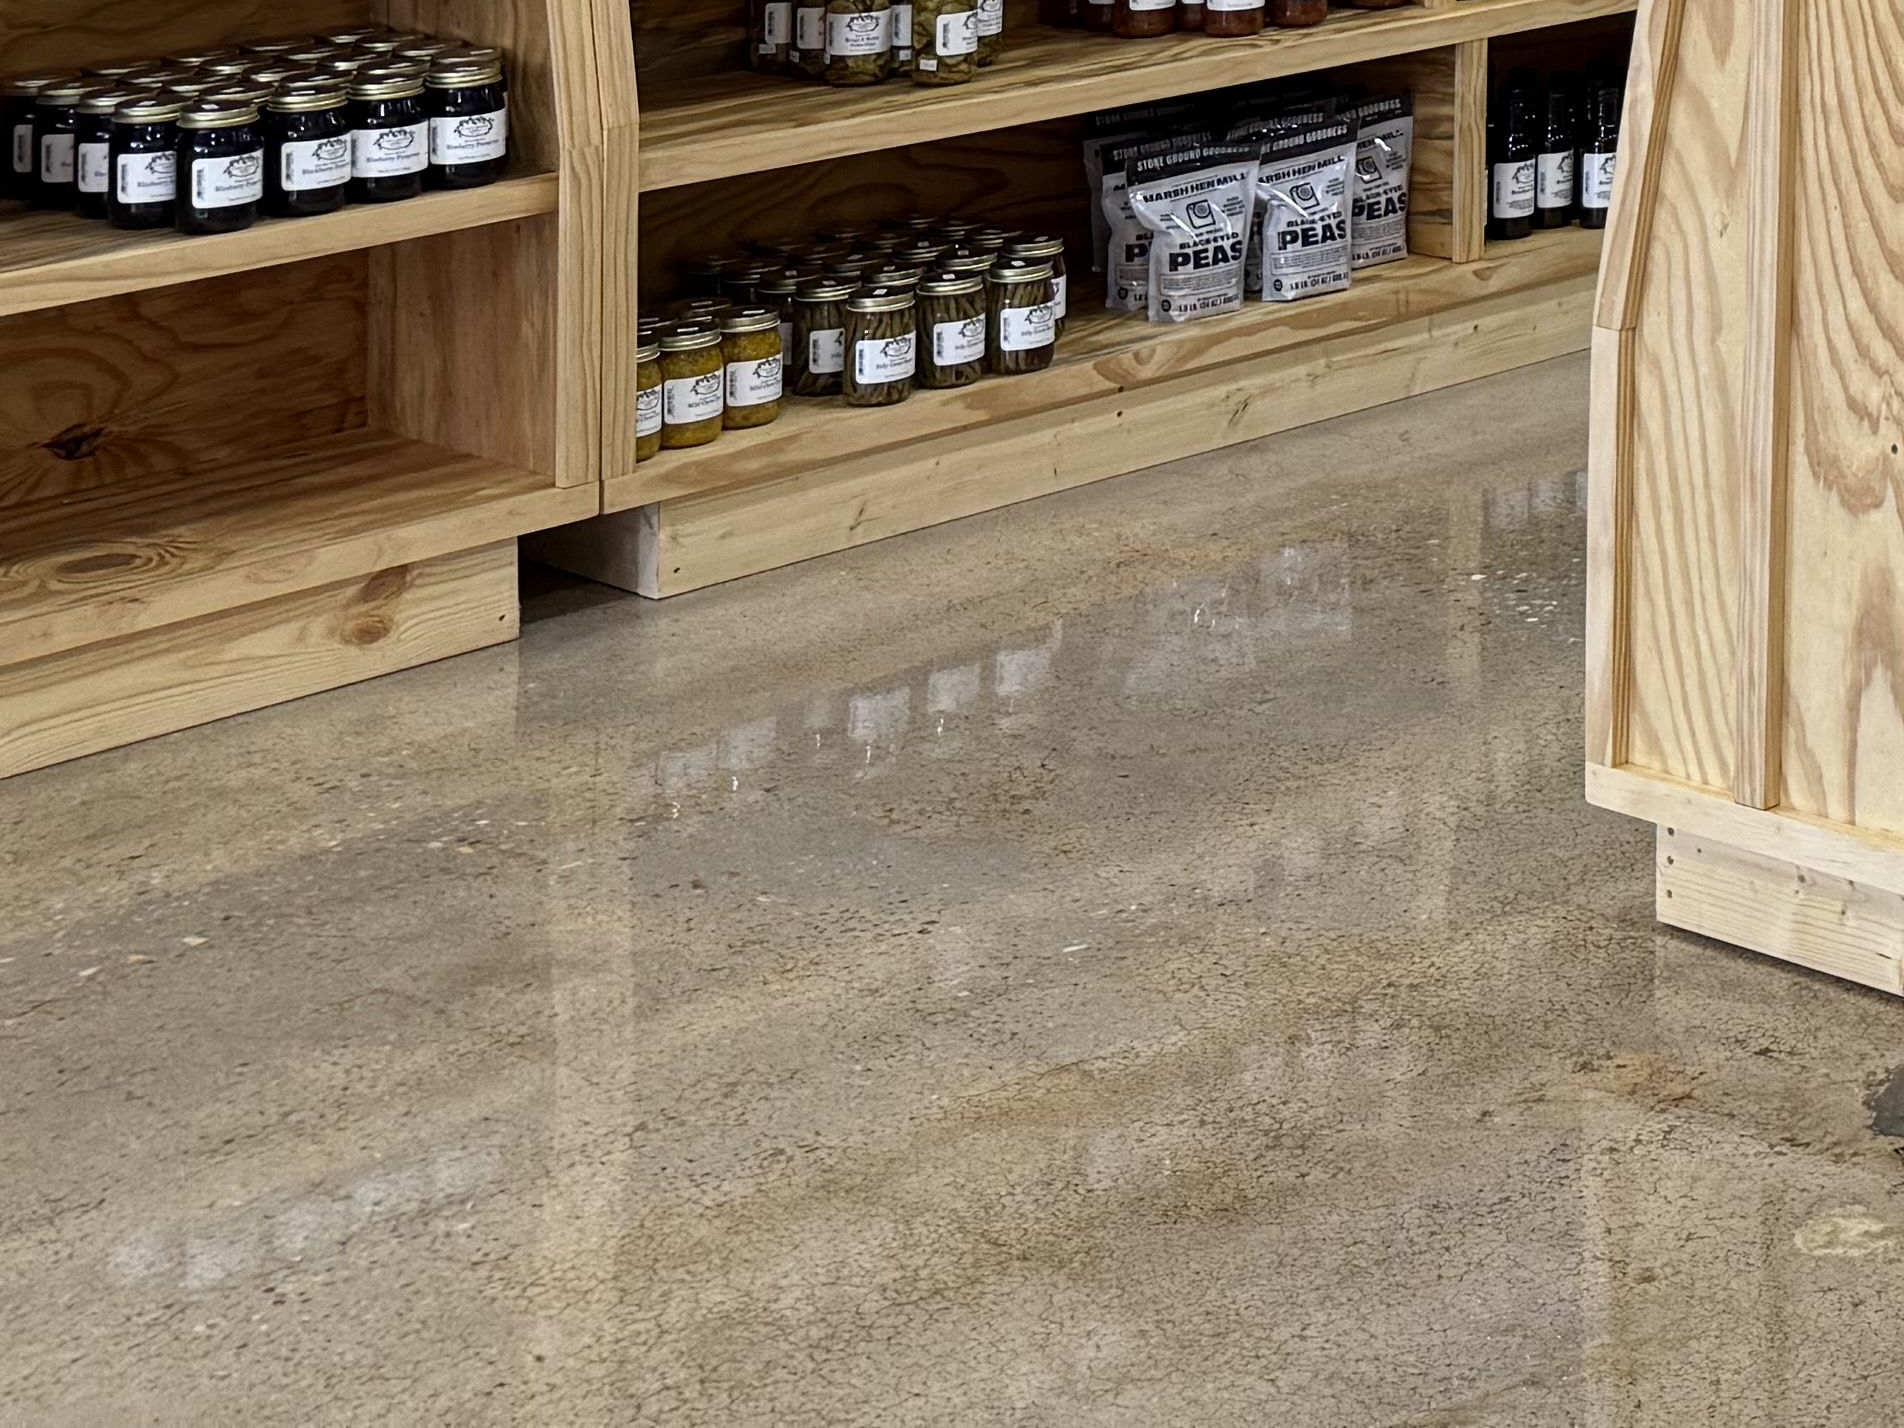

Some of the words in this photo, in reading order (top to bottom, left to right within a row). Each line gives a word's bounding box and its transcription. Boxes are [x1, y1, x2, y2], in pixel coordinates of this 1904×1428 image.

[1166, 148, 1201, 165] GROUND
[1258, 169, 1291, 185] ARSH
[1292, 163, 1317, 177] HEN
[1317, 155, 1345, 170] MILL
[1142, 186, 1189, 203] MARSH
[1190, 179, 1215, 194] HEN
[1351, 192, 1407, 221] PEAS
[1277, 219, 1347, 251] PEAS
[1168, 239, 1243, 272] PEAS
